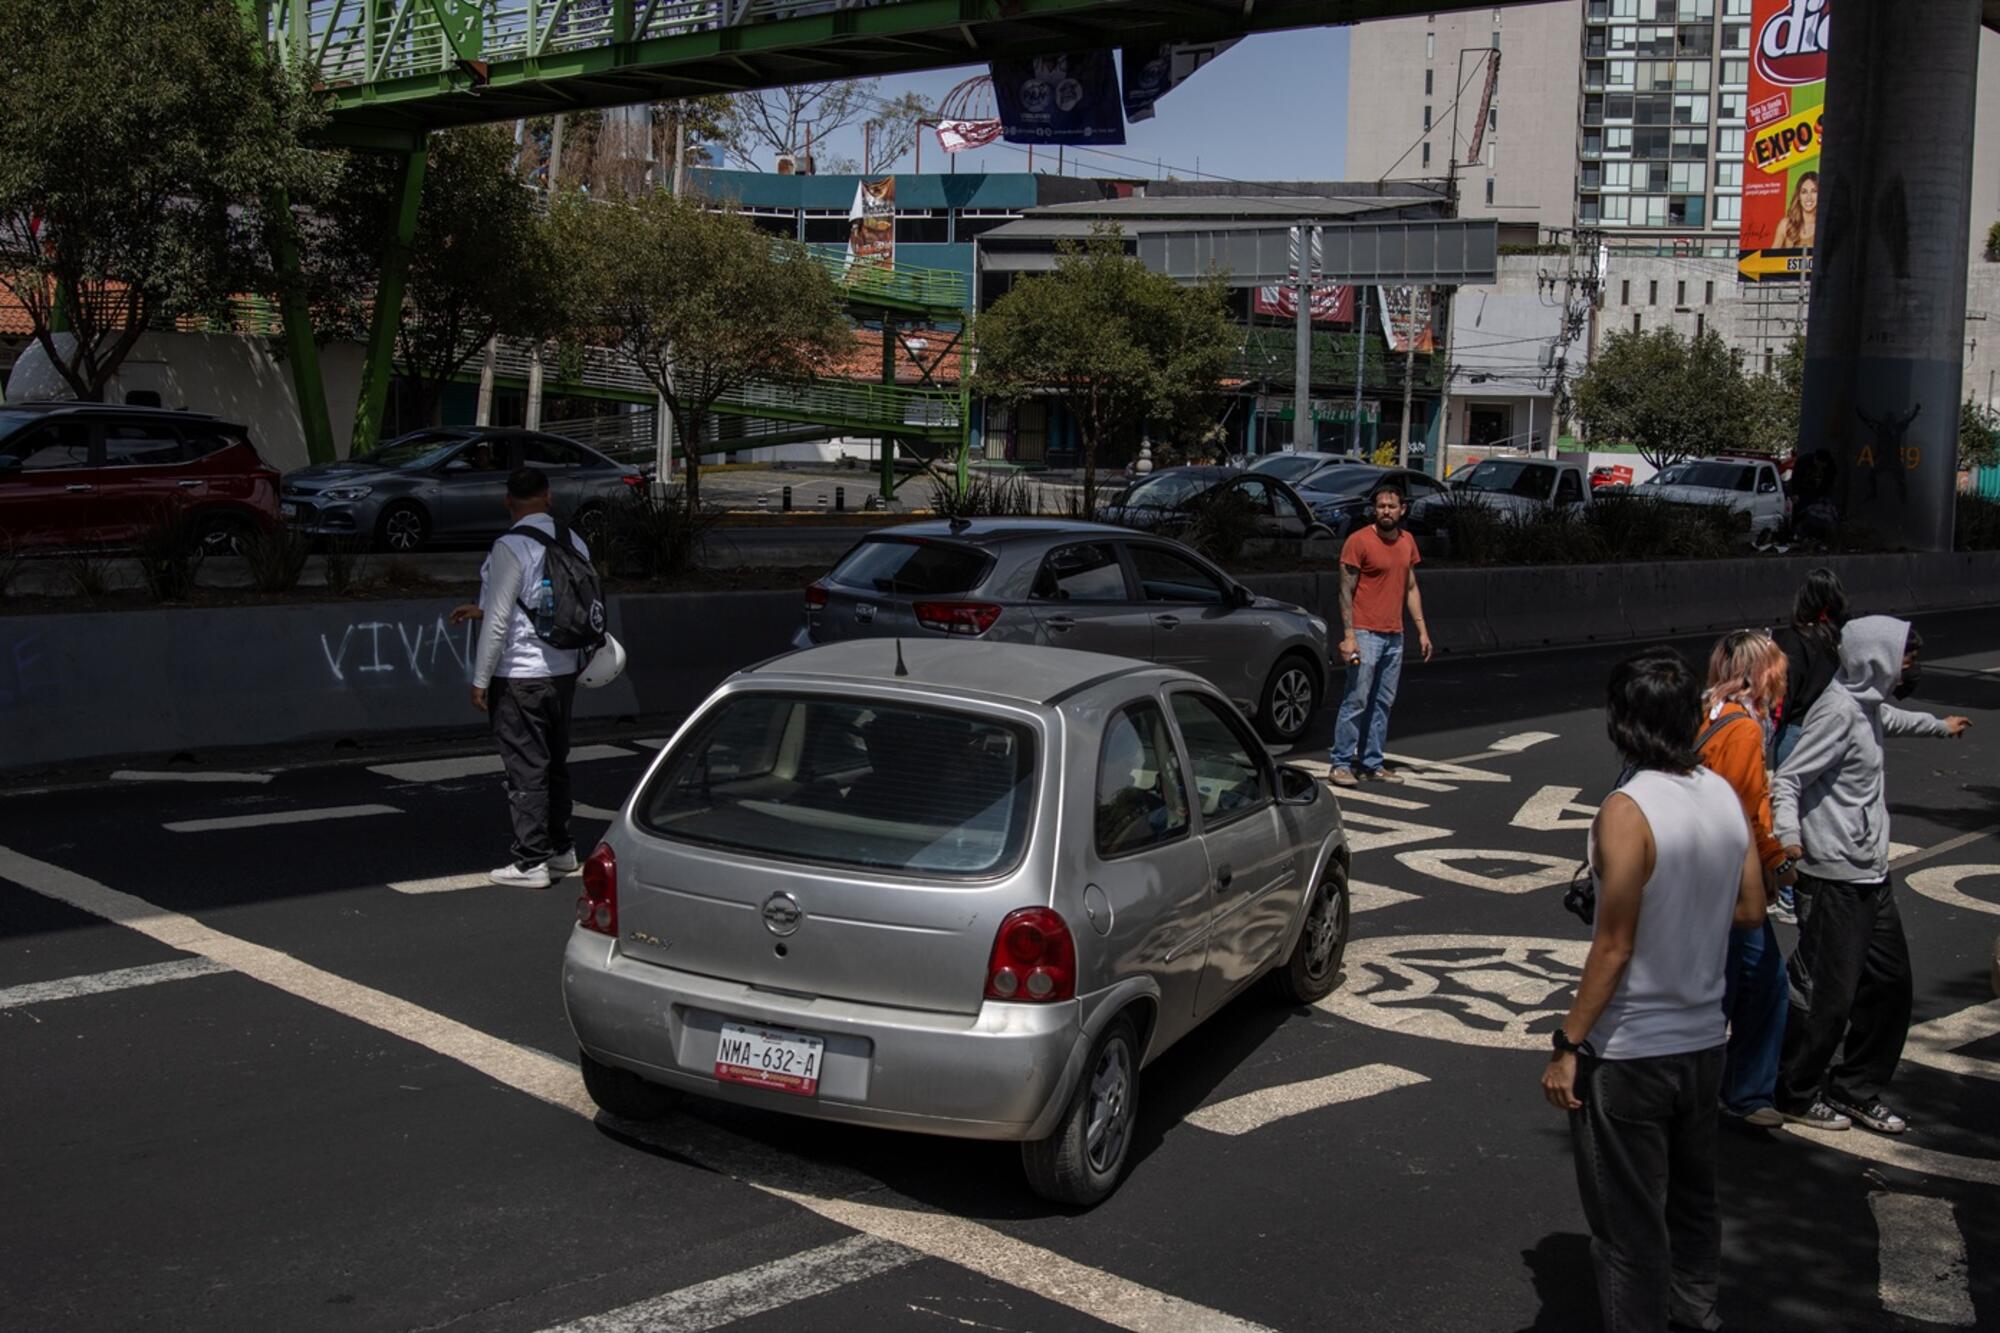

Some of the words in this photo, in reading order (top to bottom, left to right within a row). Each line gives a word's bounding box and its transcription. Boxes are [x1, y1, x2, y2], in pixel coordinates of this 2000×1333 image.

[1755, 121, 1813, 167] EXPO
[1787, 258, 1813, 270] EST
[720, 1038, 815, 1077] NMA-632-A
